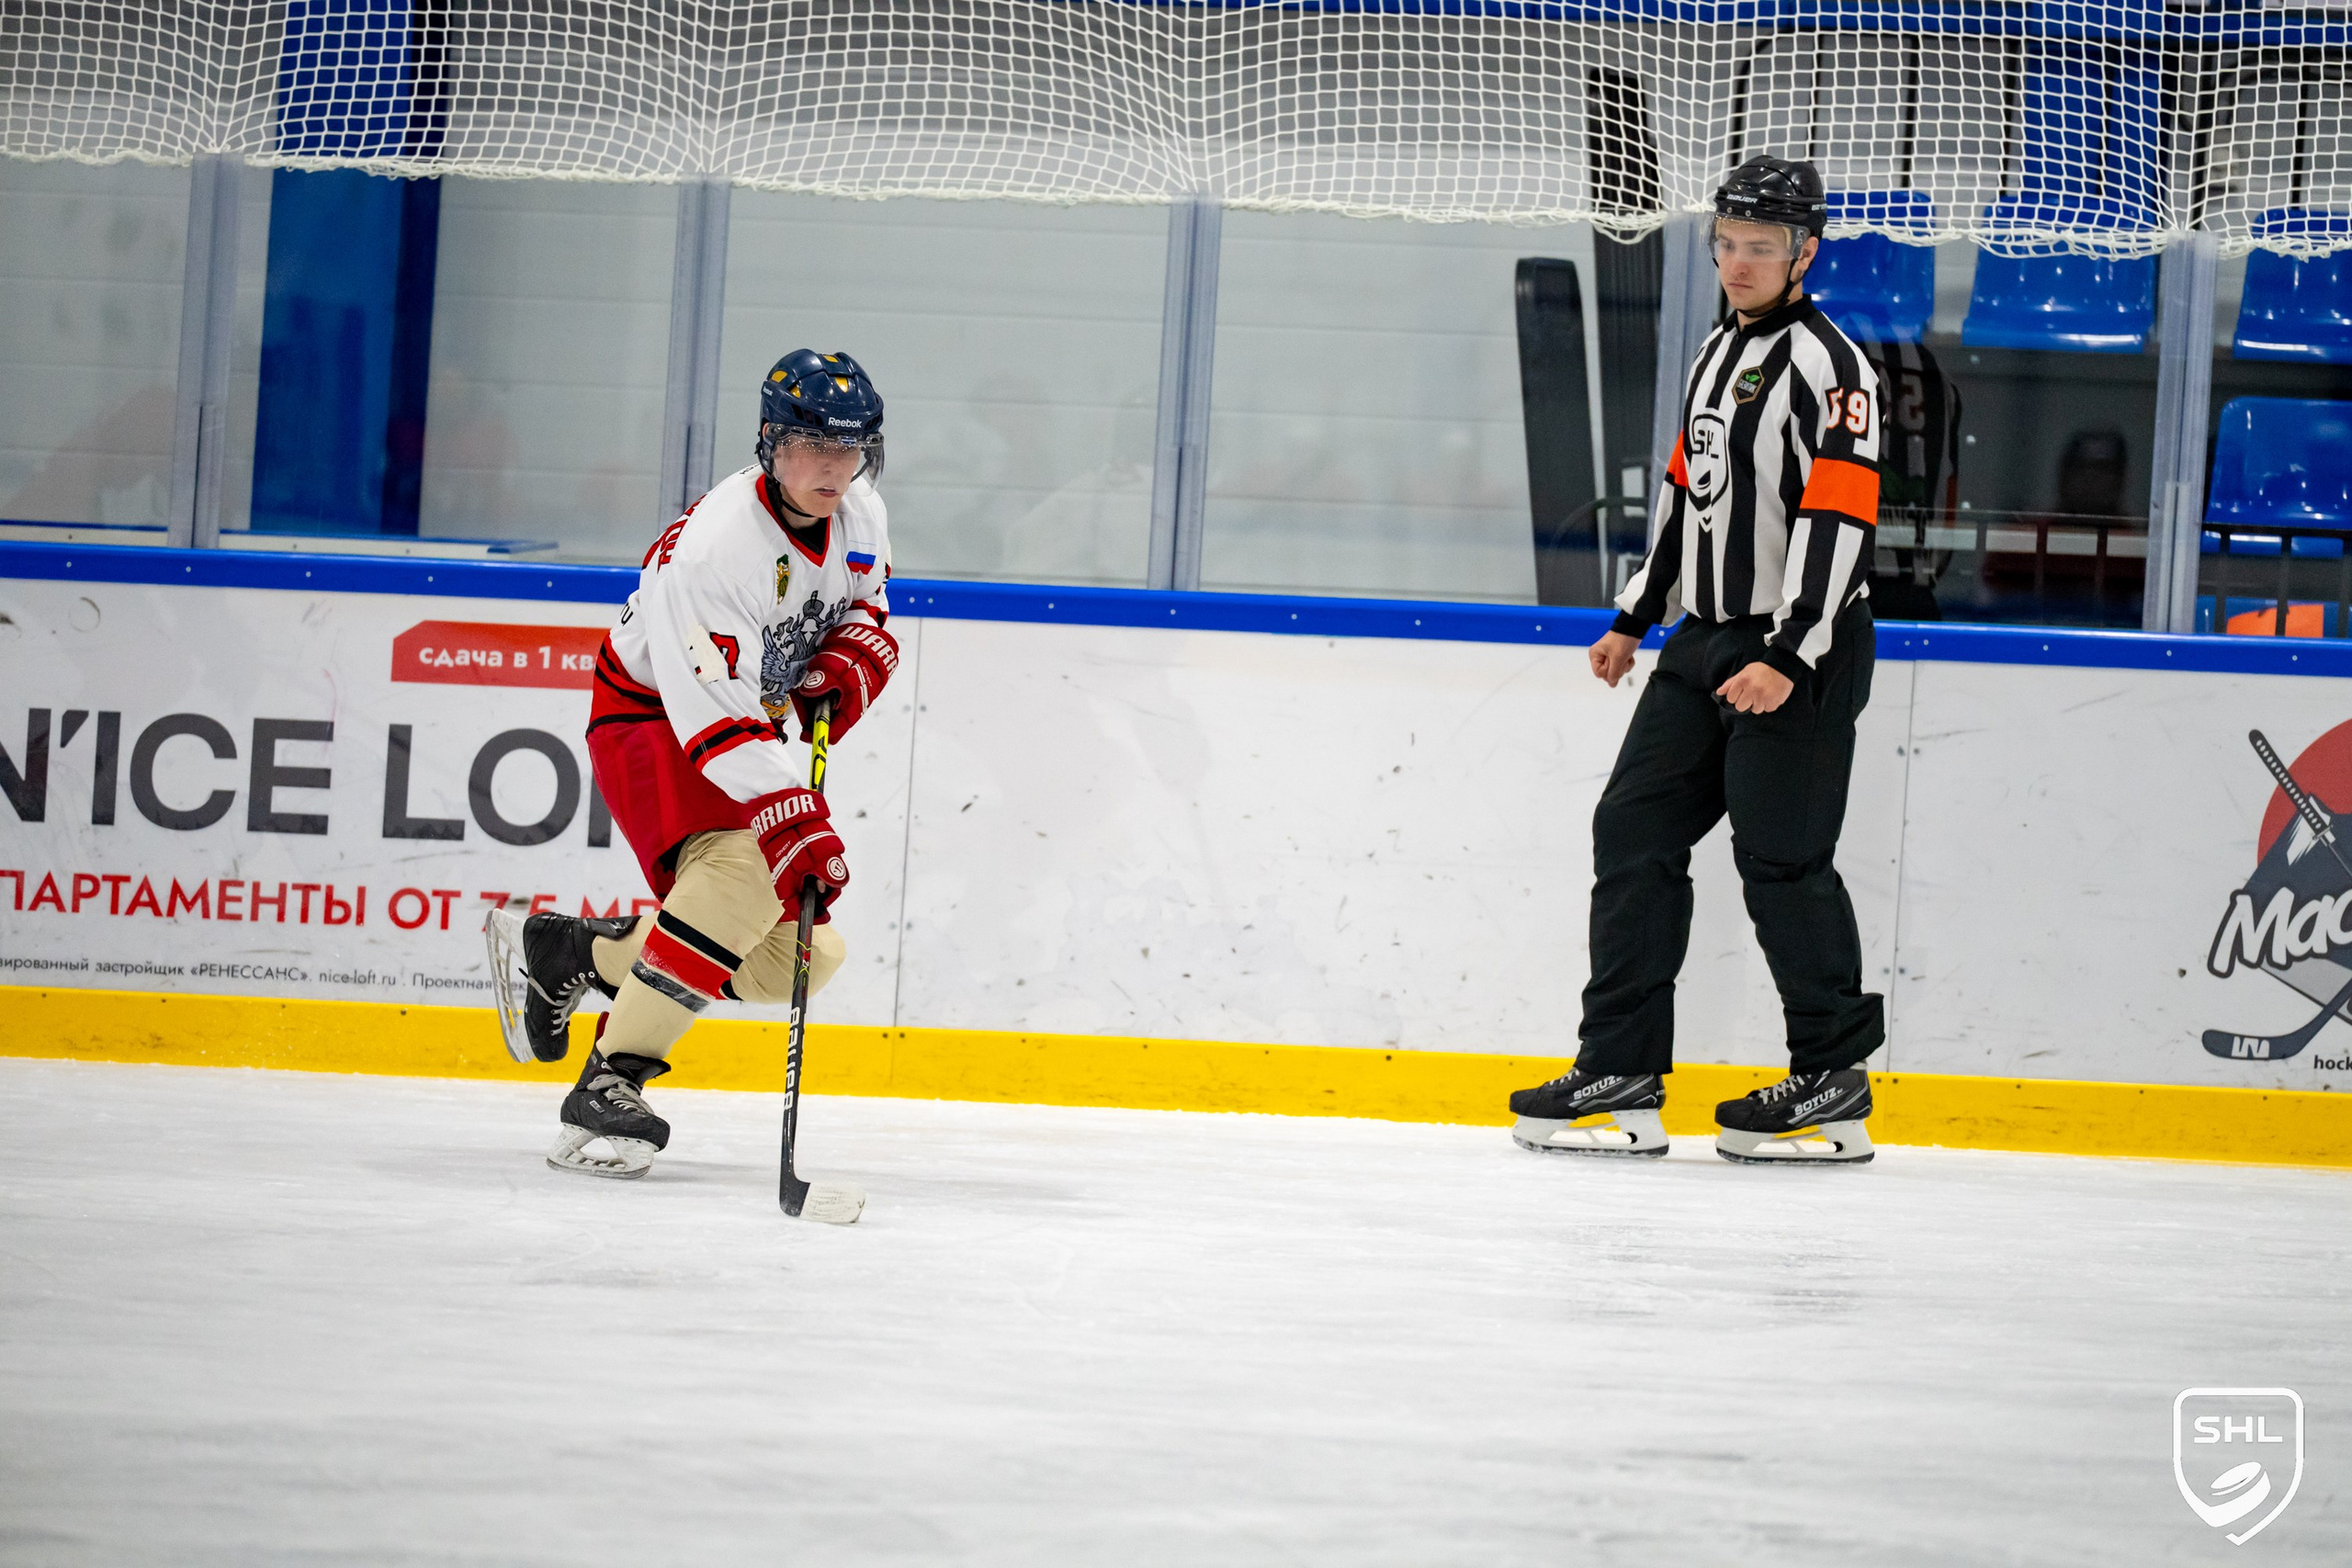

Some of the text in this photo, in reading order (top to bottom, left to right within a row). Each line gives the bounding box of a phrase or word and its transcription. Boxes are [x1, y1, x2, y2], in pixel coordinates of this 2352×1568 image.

[1727, 193, 1758, 204] BAUER
[828, 416, 862, 429] Reebok
[1826, 387, 1869, 434] 59
[419, 647, 503, 669] сдача
[514, 651, 528, 669] в
[538, 645, 551, 670] 1
[388, 886, 461, 931] ОТ
[96, 960, 184, 976] застройщик
[319, 968, 396, 987] nice-loft.ru
[413, 972, 492, 990] Проектная
[1573, 1075, 1616, 1100] SOYUZ
[1794, 1086, 1837, 1116] SOYUZ
